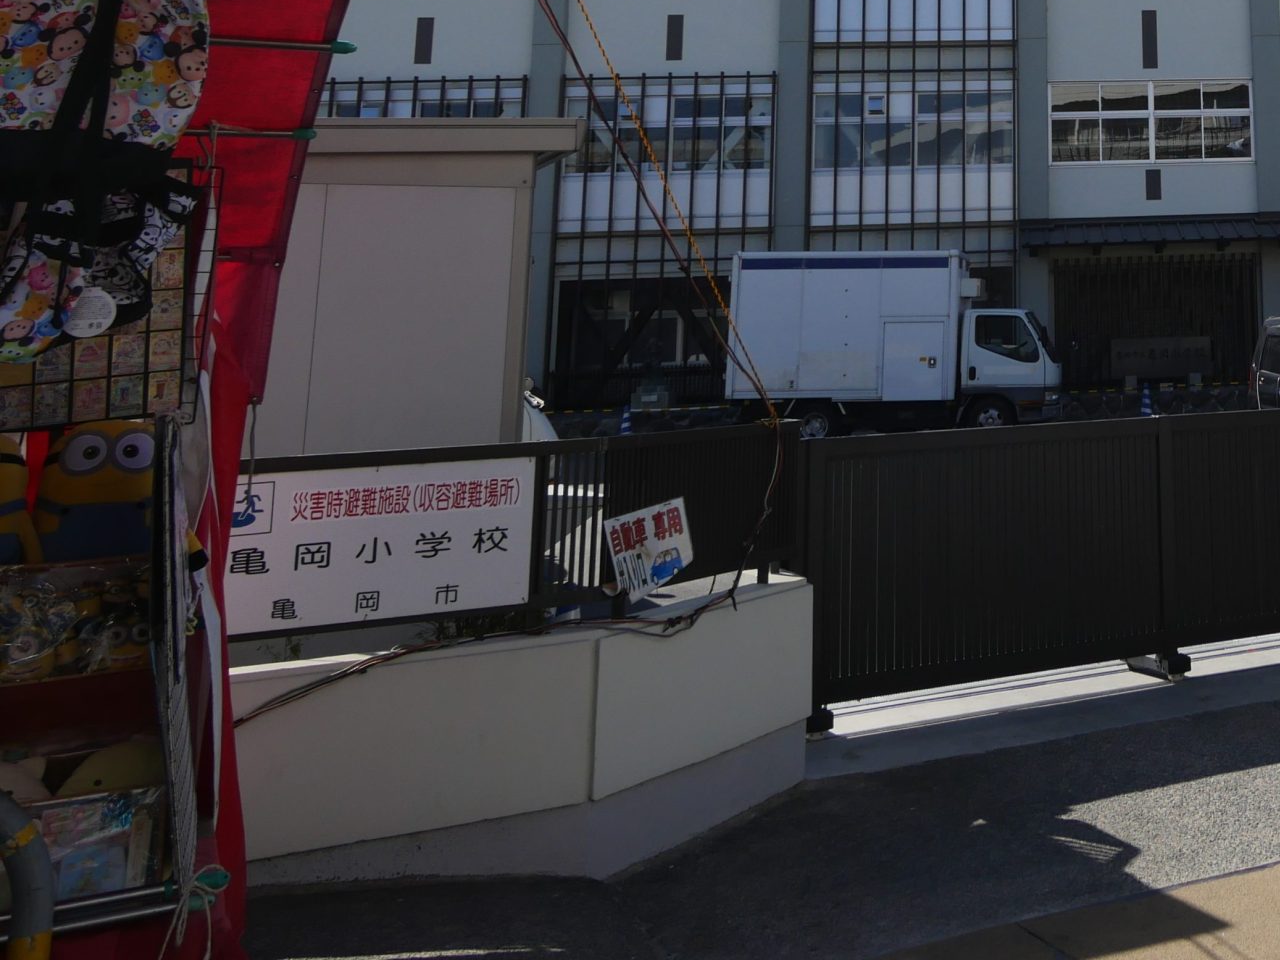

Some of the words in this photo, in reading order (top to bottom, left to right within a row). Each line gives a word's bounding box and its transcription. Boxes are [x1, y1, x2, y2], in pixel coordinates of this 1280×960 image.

[230, 526, 510, 576] 亀岡小学校
[609, 516, 648, 557] 自動車
[652, 506, 684, 541] 専用
[616, 553, 648, 594] 出入り口
[271, 583, 460, 621] 亀岡市
